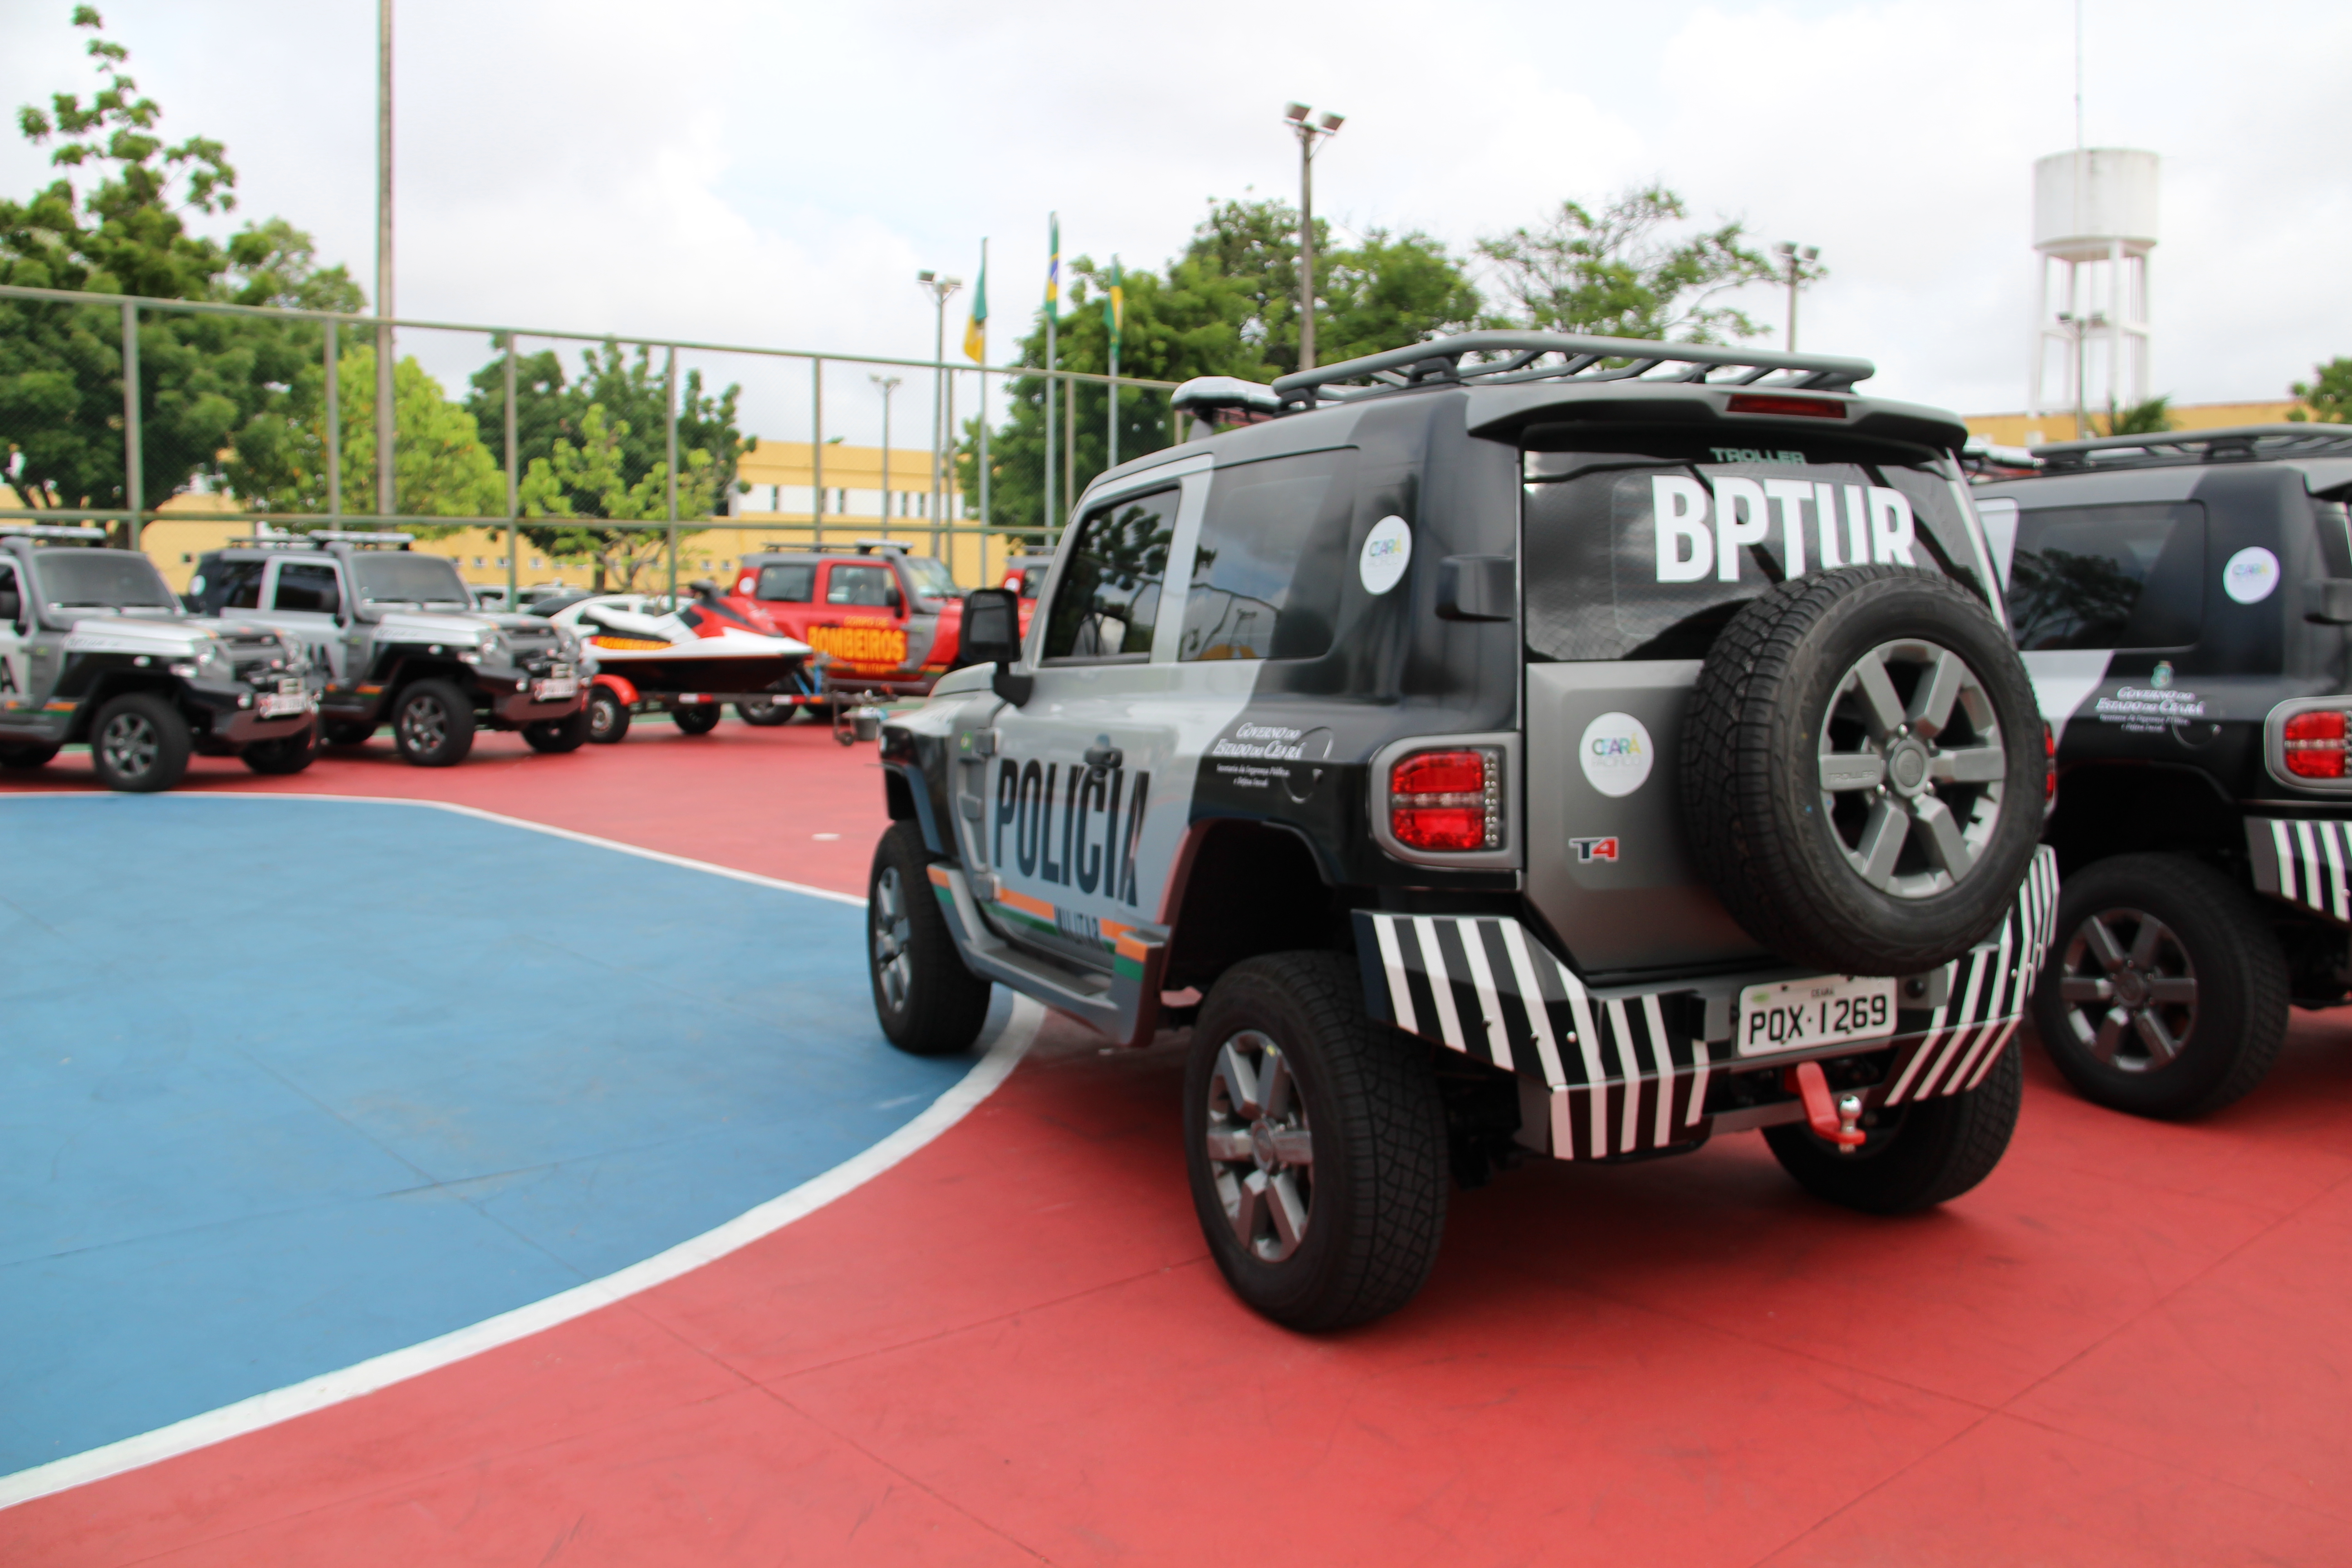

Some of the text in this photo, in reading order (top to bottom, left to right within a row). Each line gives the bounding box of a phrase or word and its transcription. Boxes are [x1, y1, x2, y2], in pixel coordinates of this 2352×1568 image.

[1709, 446, 1807, 465] TROLLER
[1651, 475, 1916, 583] BPTUR
[807, 626, 906, 662] BOMBEIROS
[2117, 686, 2195, 702] GOVERNO DO
[2095, 697, 2206, 716] ESTADO DO CEARÁ
[1236, 722, 1302, 740] GOVERNO DO
[1212, 739, 1308, 760] ESTADO DO CEARÁ
[1592, 732, 1642, 756] CEARÁ
[1568, 836, 1619, 863] T4
